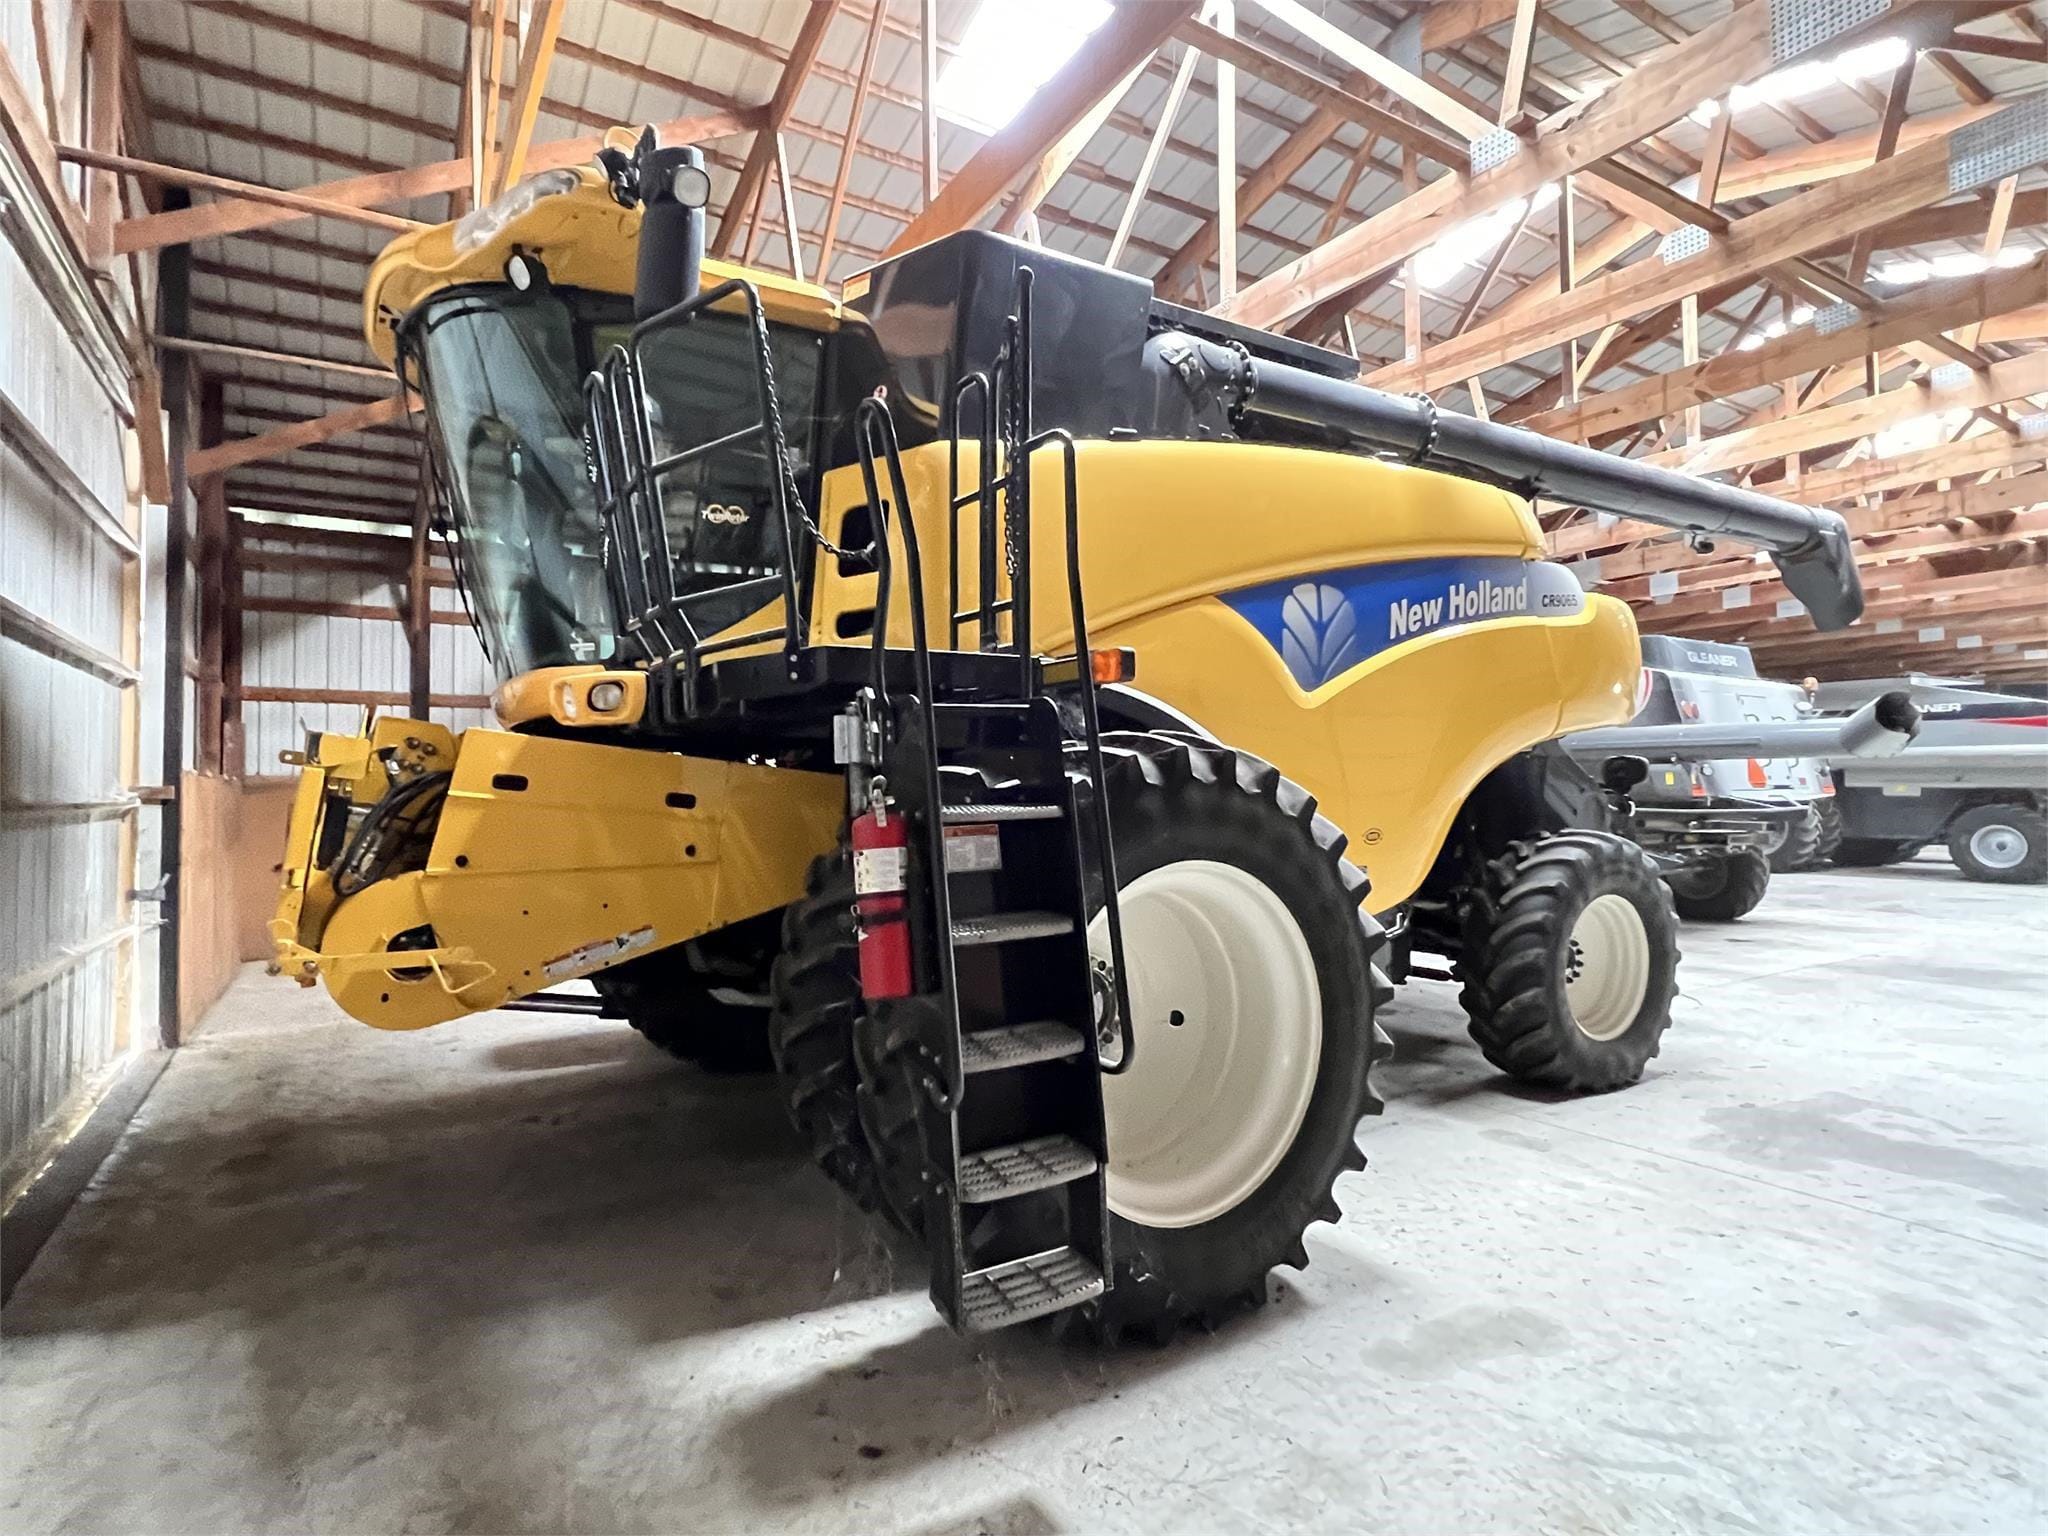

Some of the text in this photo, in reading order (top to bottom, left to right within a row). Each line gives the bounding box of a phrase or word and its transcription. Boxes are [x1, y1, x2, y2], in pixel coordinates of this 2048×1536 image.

[1390, 576, 1527, 639] New Holland
[1687, 651, 1738, 667] GLEANER
